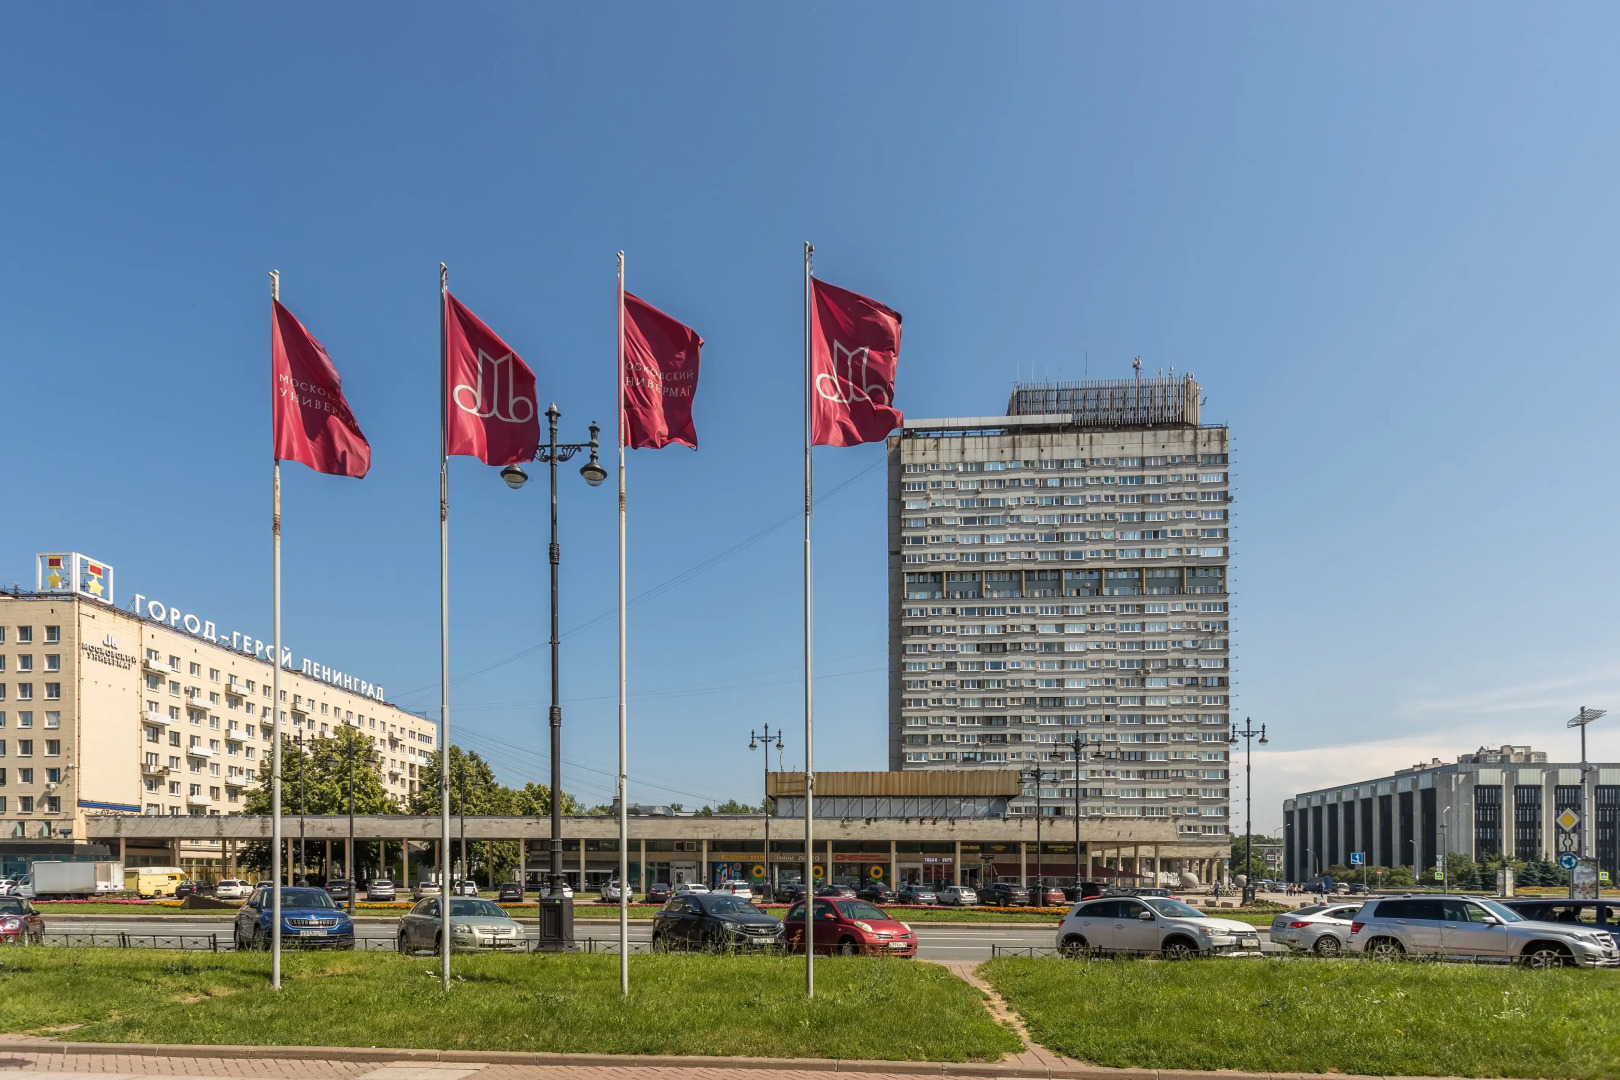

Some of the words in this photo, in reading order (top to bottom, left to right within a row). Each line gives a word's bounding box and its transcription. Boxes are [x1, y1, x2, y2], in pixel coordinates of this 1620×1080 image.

[624, 361, 694, 382] ОСКОВСКИЙ
[624, 376, 692, 397] НИВЕРМАГ
[134, 593, 292, 668] ГОРОД-ГЕРОЙ
[301, 657, 385, 703] ЛЕНИНГРАД
